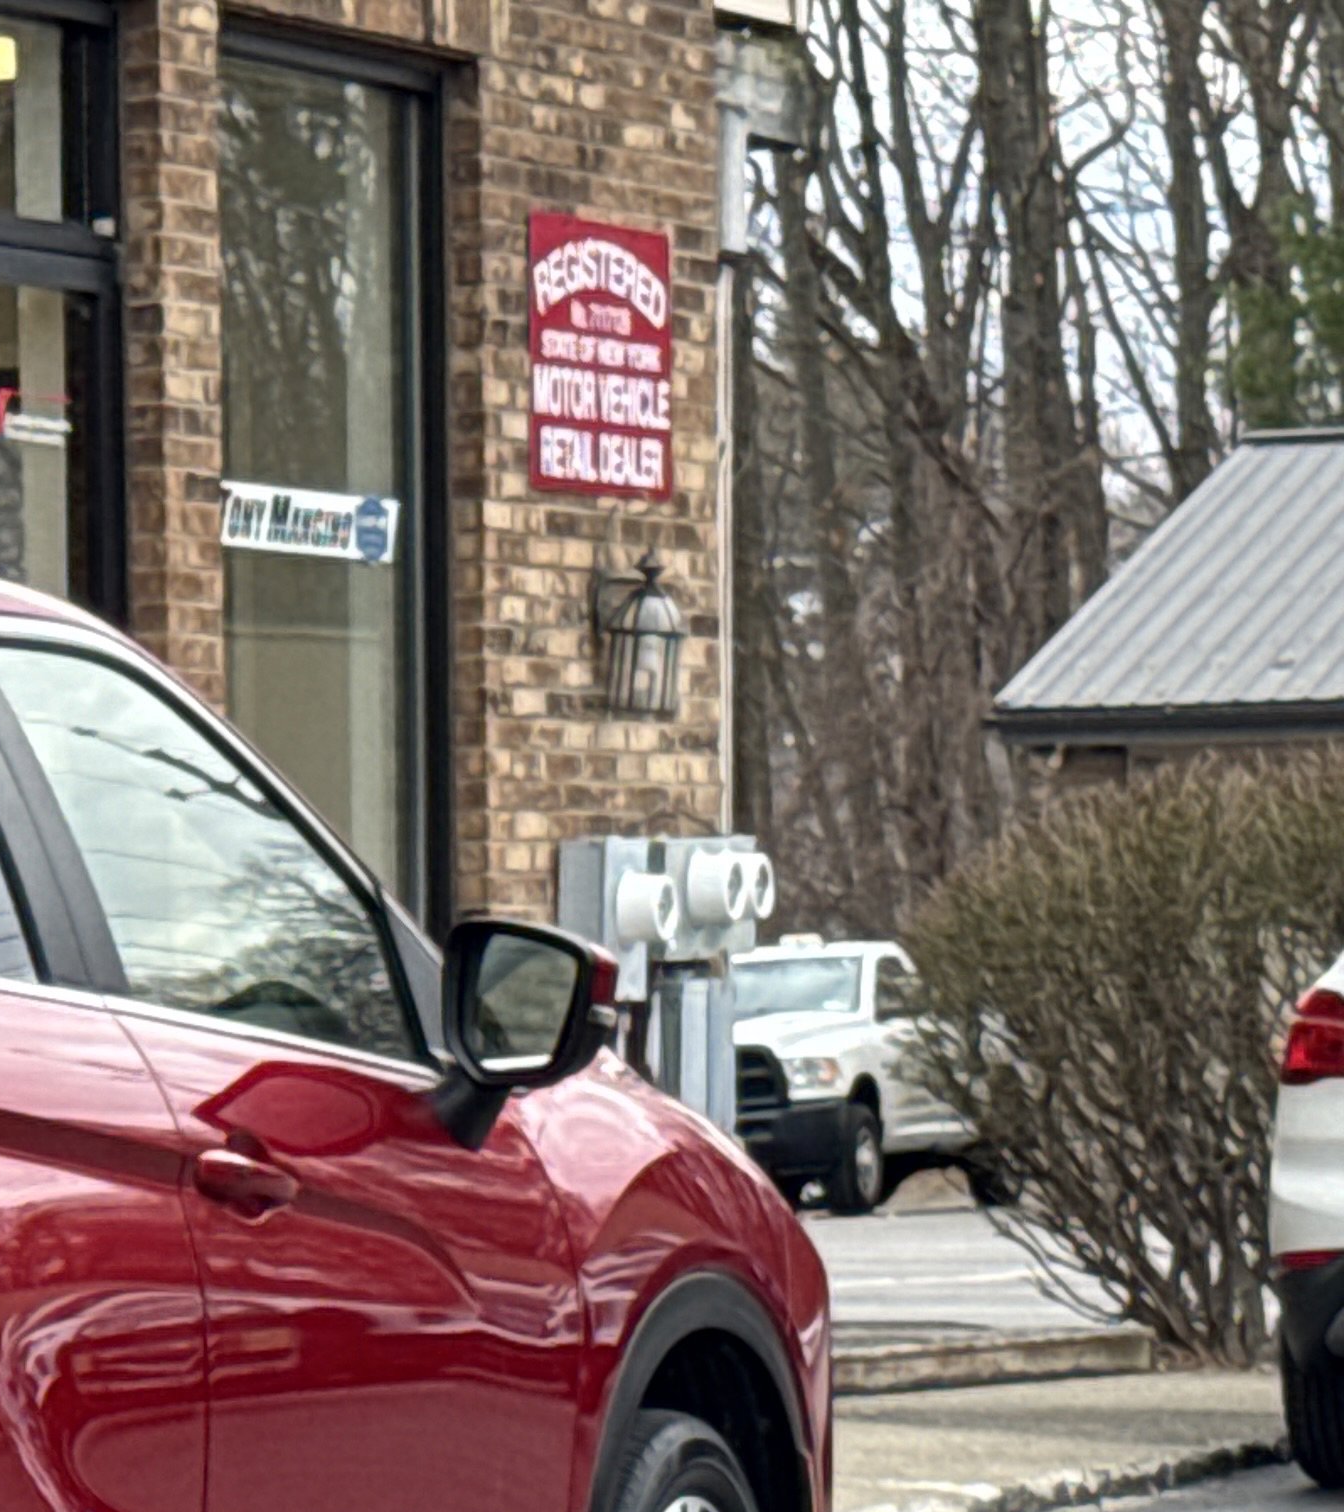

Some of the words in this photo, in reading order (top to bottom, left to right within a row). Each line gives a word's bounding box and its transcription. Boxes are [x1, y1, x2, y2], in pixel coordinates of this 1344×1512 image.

[533, 237, 667, 330] REGISTERED
[533, 363, 598, 423] MOTOR
[597, 372, 671, 430] VEHICLE
[540, 425, 598, 483] RETAIL
[598, 431, 664, 491] DEALER
